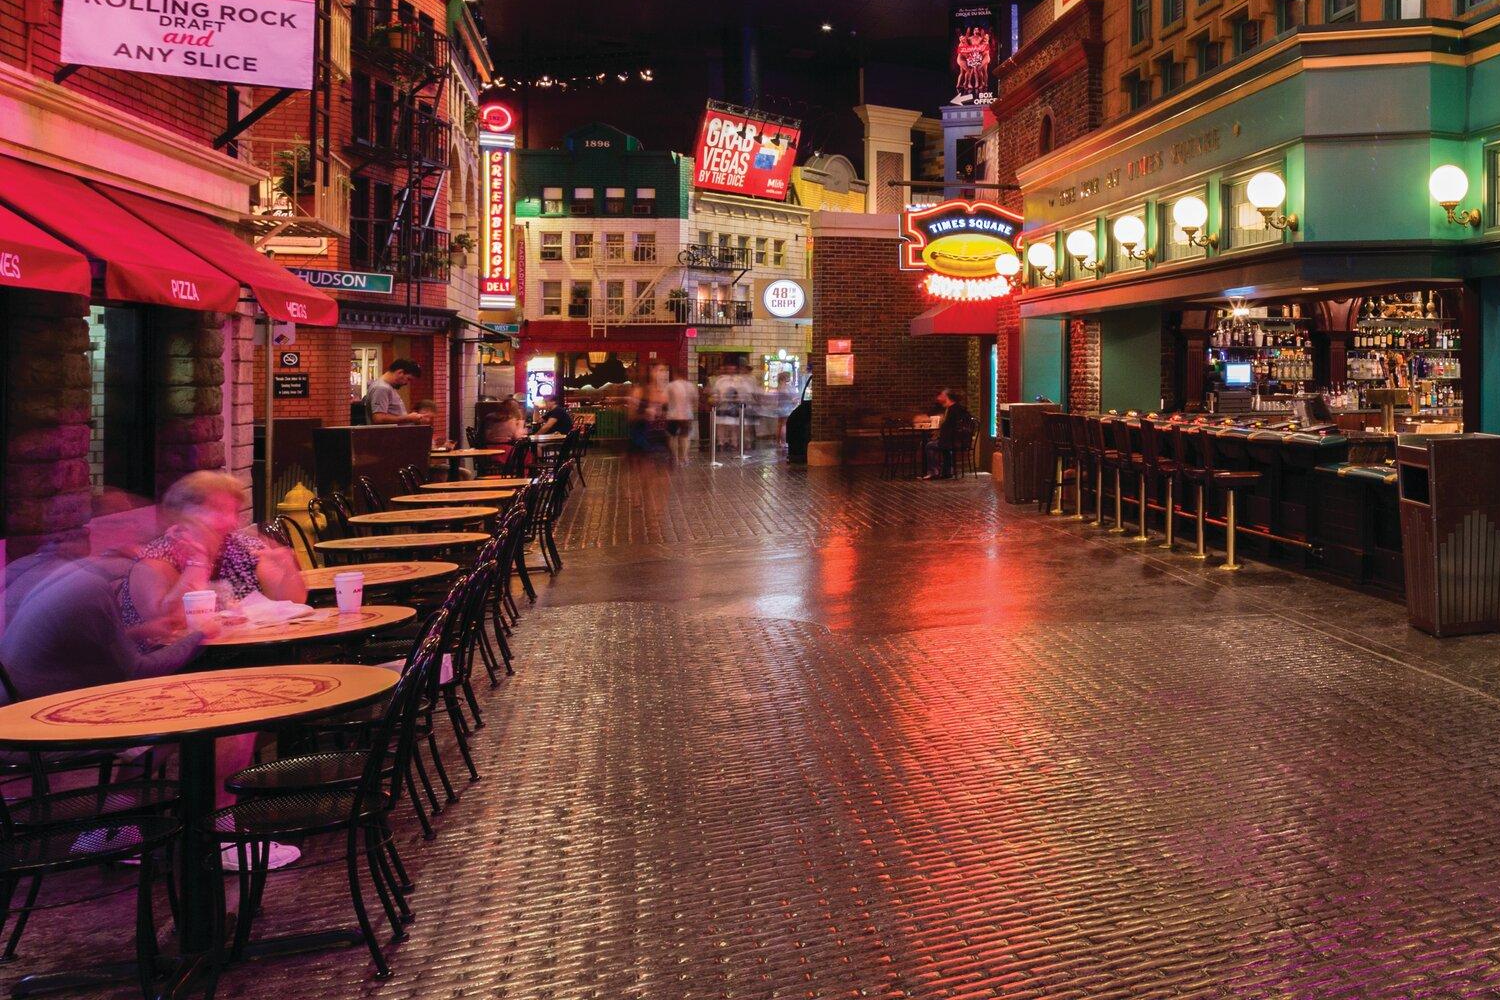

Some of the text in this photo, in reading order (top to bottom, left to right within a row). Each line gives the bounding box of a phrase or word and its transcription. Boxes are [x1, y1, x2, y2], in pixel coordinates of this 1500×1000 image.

[159, 15, 226, 32] DRAFT
[220, 5, 297, 29] ROCK
[162, 30, 215, 47] and
[113, 43, 258, 72] ANY SLICE
[585, 140, 610, 148] 1896
[706, 117, 757, 152] GRAB
[702, 146, 750, 175] VEGAS
[698, 170, 745, 187] BY THE DICE
[929, 217, 1013, 236] TIMES SQUARE
[298, 270, 367, 288] HUDSON
[171, 279, 200, 301] PIZZA
